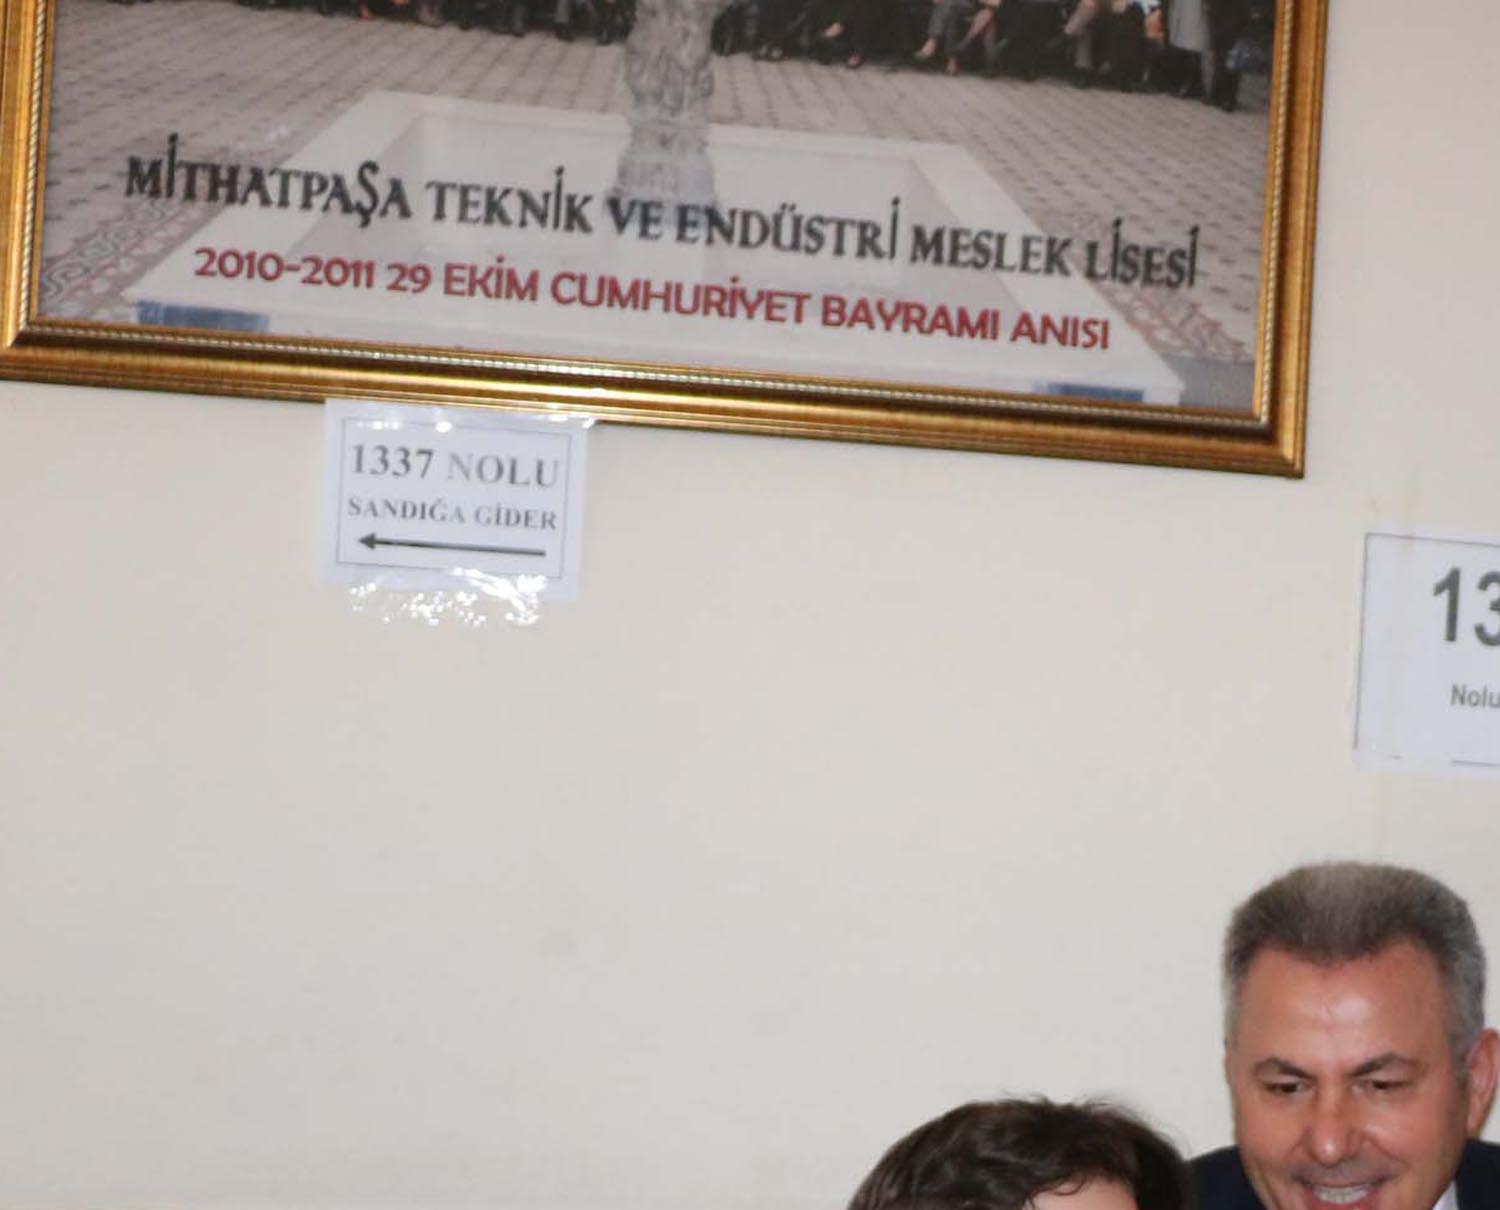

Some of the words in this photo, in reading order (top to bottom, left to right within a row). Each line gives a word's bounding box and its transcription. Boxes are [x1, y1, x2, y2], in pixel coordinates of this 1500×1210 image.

[125, 133, 411, 229] MİTHATPAŞA
[426, 166, 593, 234] TEKNİK
[607, 197, 662, 240] VE
[676, 196, 901, 260] ENDÜSTRİ
[910, 224, 1072, 280] MESLEK
[1085, 216, 1200, 288] LİSESİ
[194, 246, 375, 289] 2010-2011
[387, 262, 432, 294] 29
[443, 256, 540, 302] EKİM
[551, 270, 811, 324] CUMHURİYET
[820, 297, 998, 341] BAYRAMI
[1009, 307, 1110, 350] ANISI
[351, 444, 434, 479] 1337
[448, 452, 559, 488] NOLU
[348, 497, 465, 524] SANDIĞA
